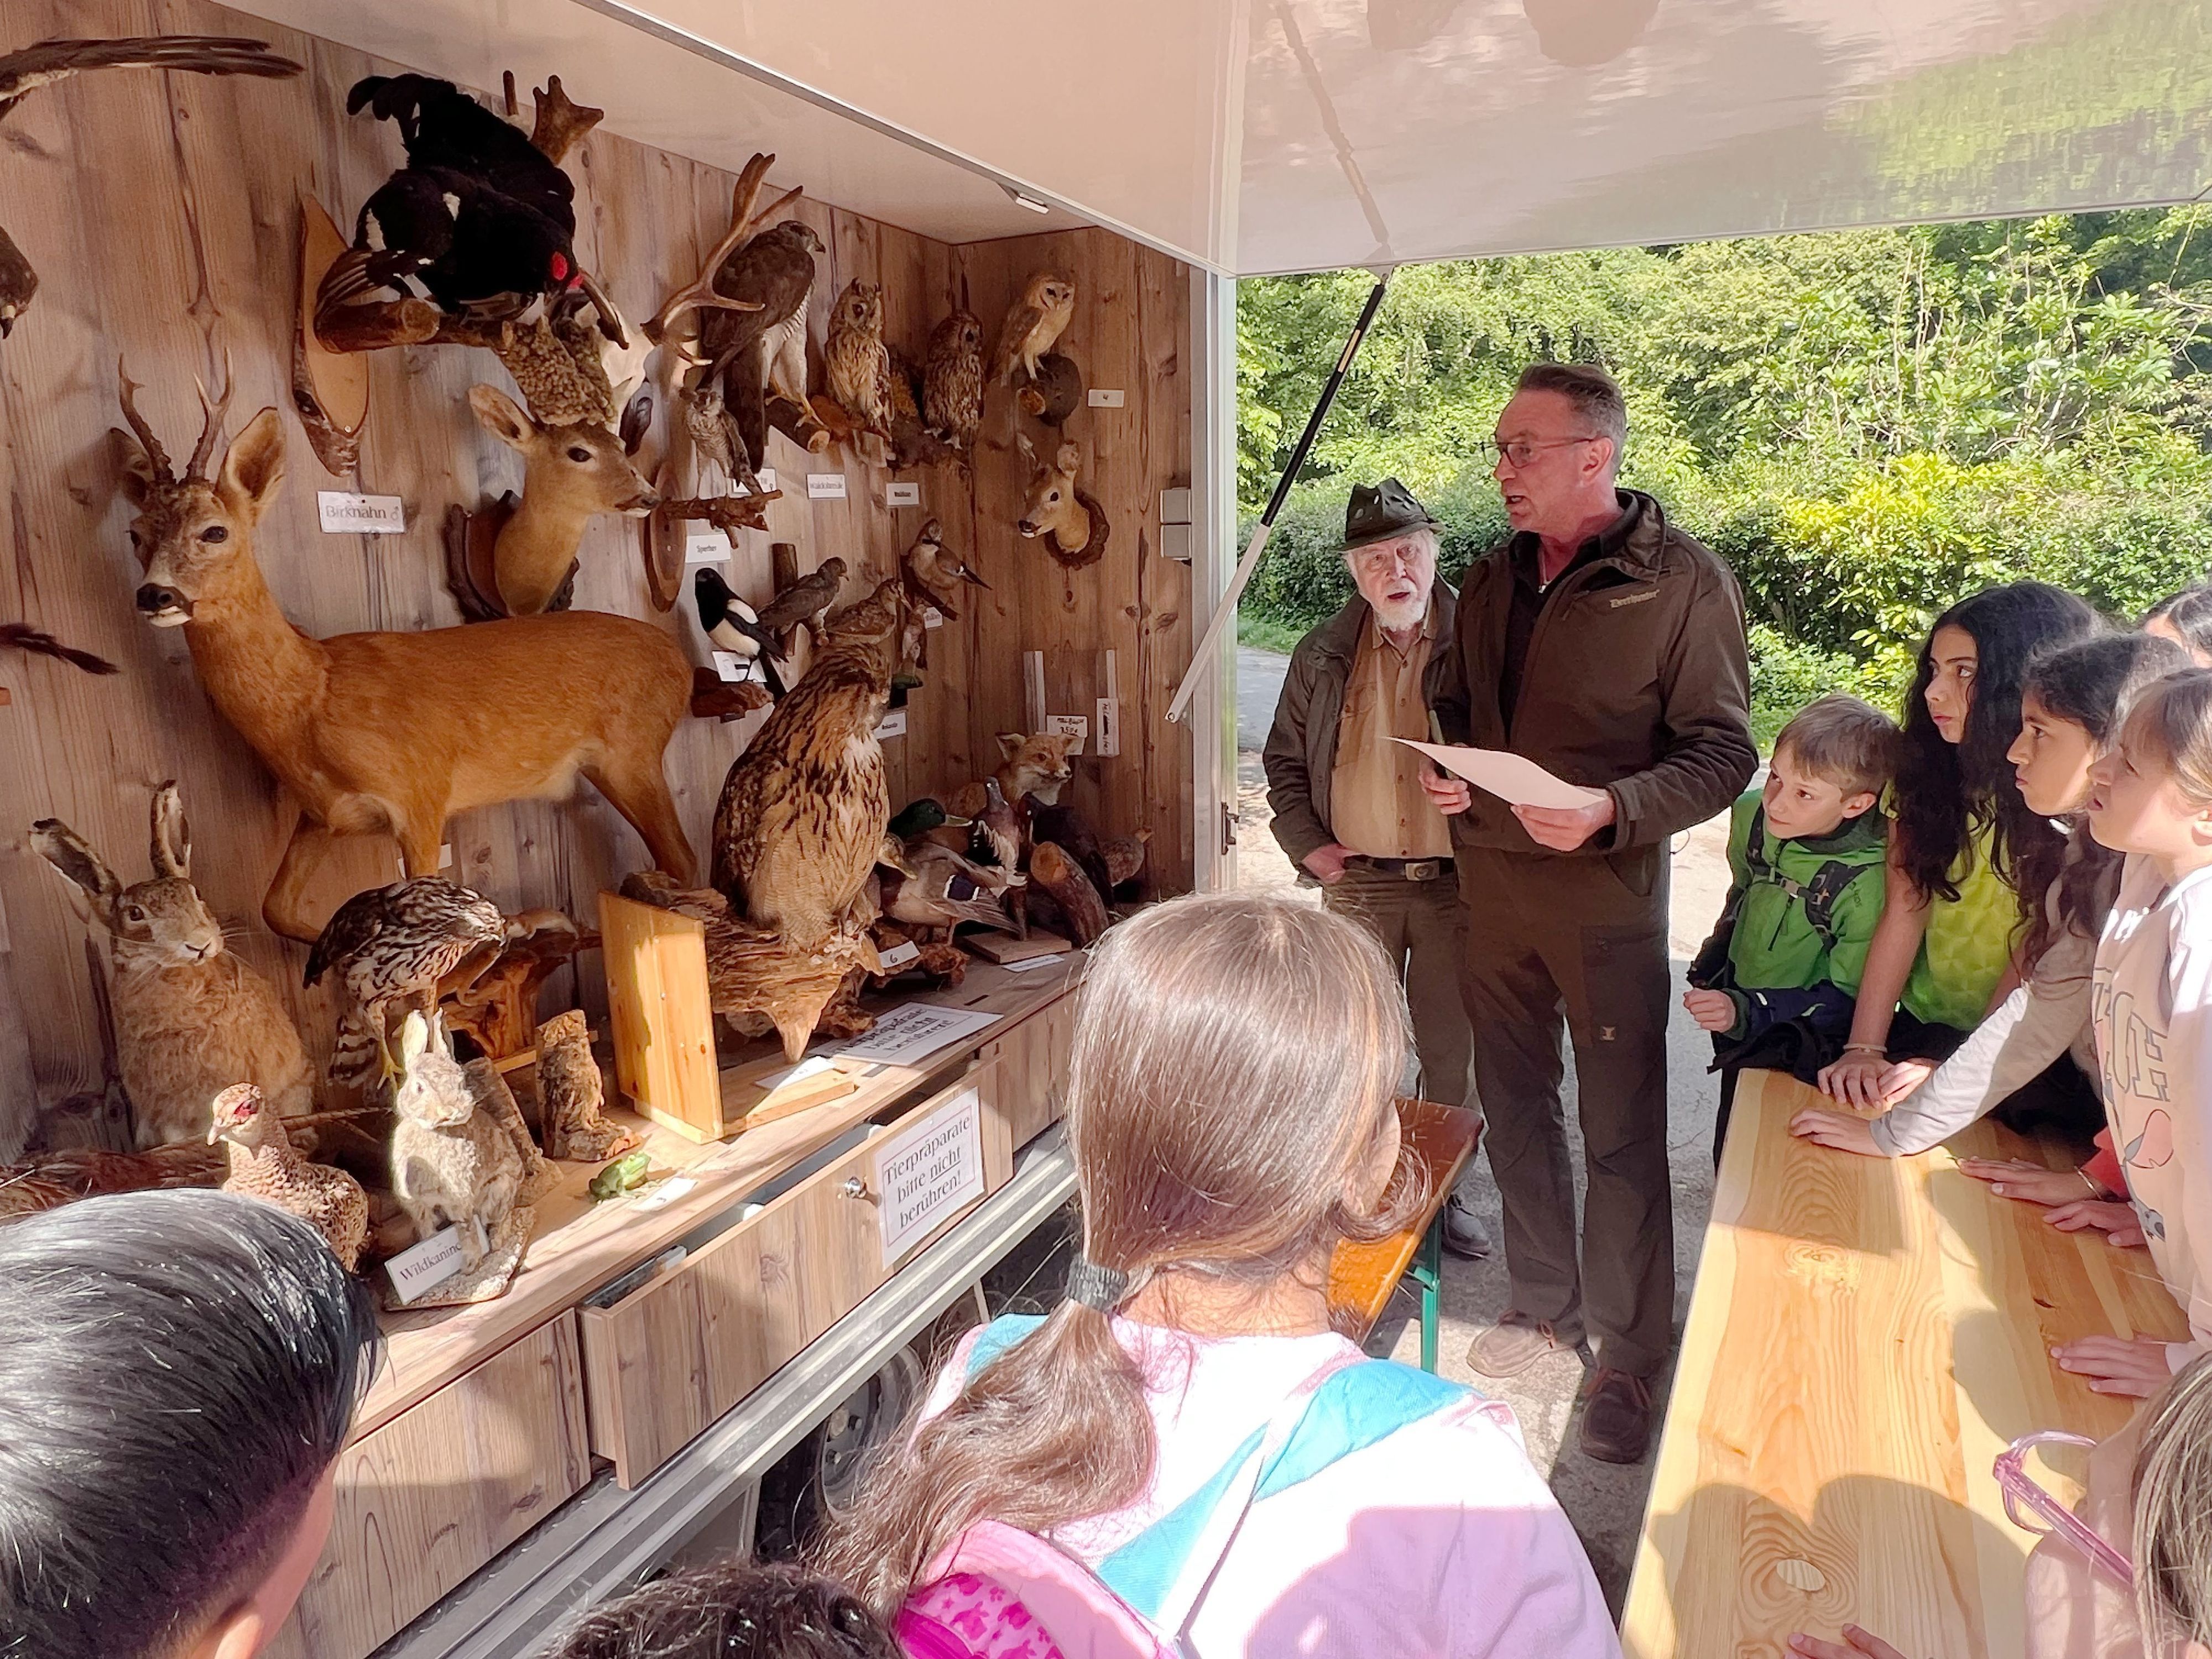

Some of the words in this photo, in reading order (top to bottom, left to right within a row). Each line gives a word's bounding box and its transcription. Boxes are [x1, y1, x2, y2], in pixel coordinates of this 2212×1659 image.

[890, 953, 899, 963] 6
[885, 1116, 971, 1185] Tierpräparate
[898, 1171, 926, 1204] bitte
[930, 1145, 961, 1179] nicht
[900, 1170, 962, 1229] berühren!
[399, 1241, 462, 1281] Wildkaninc
